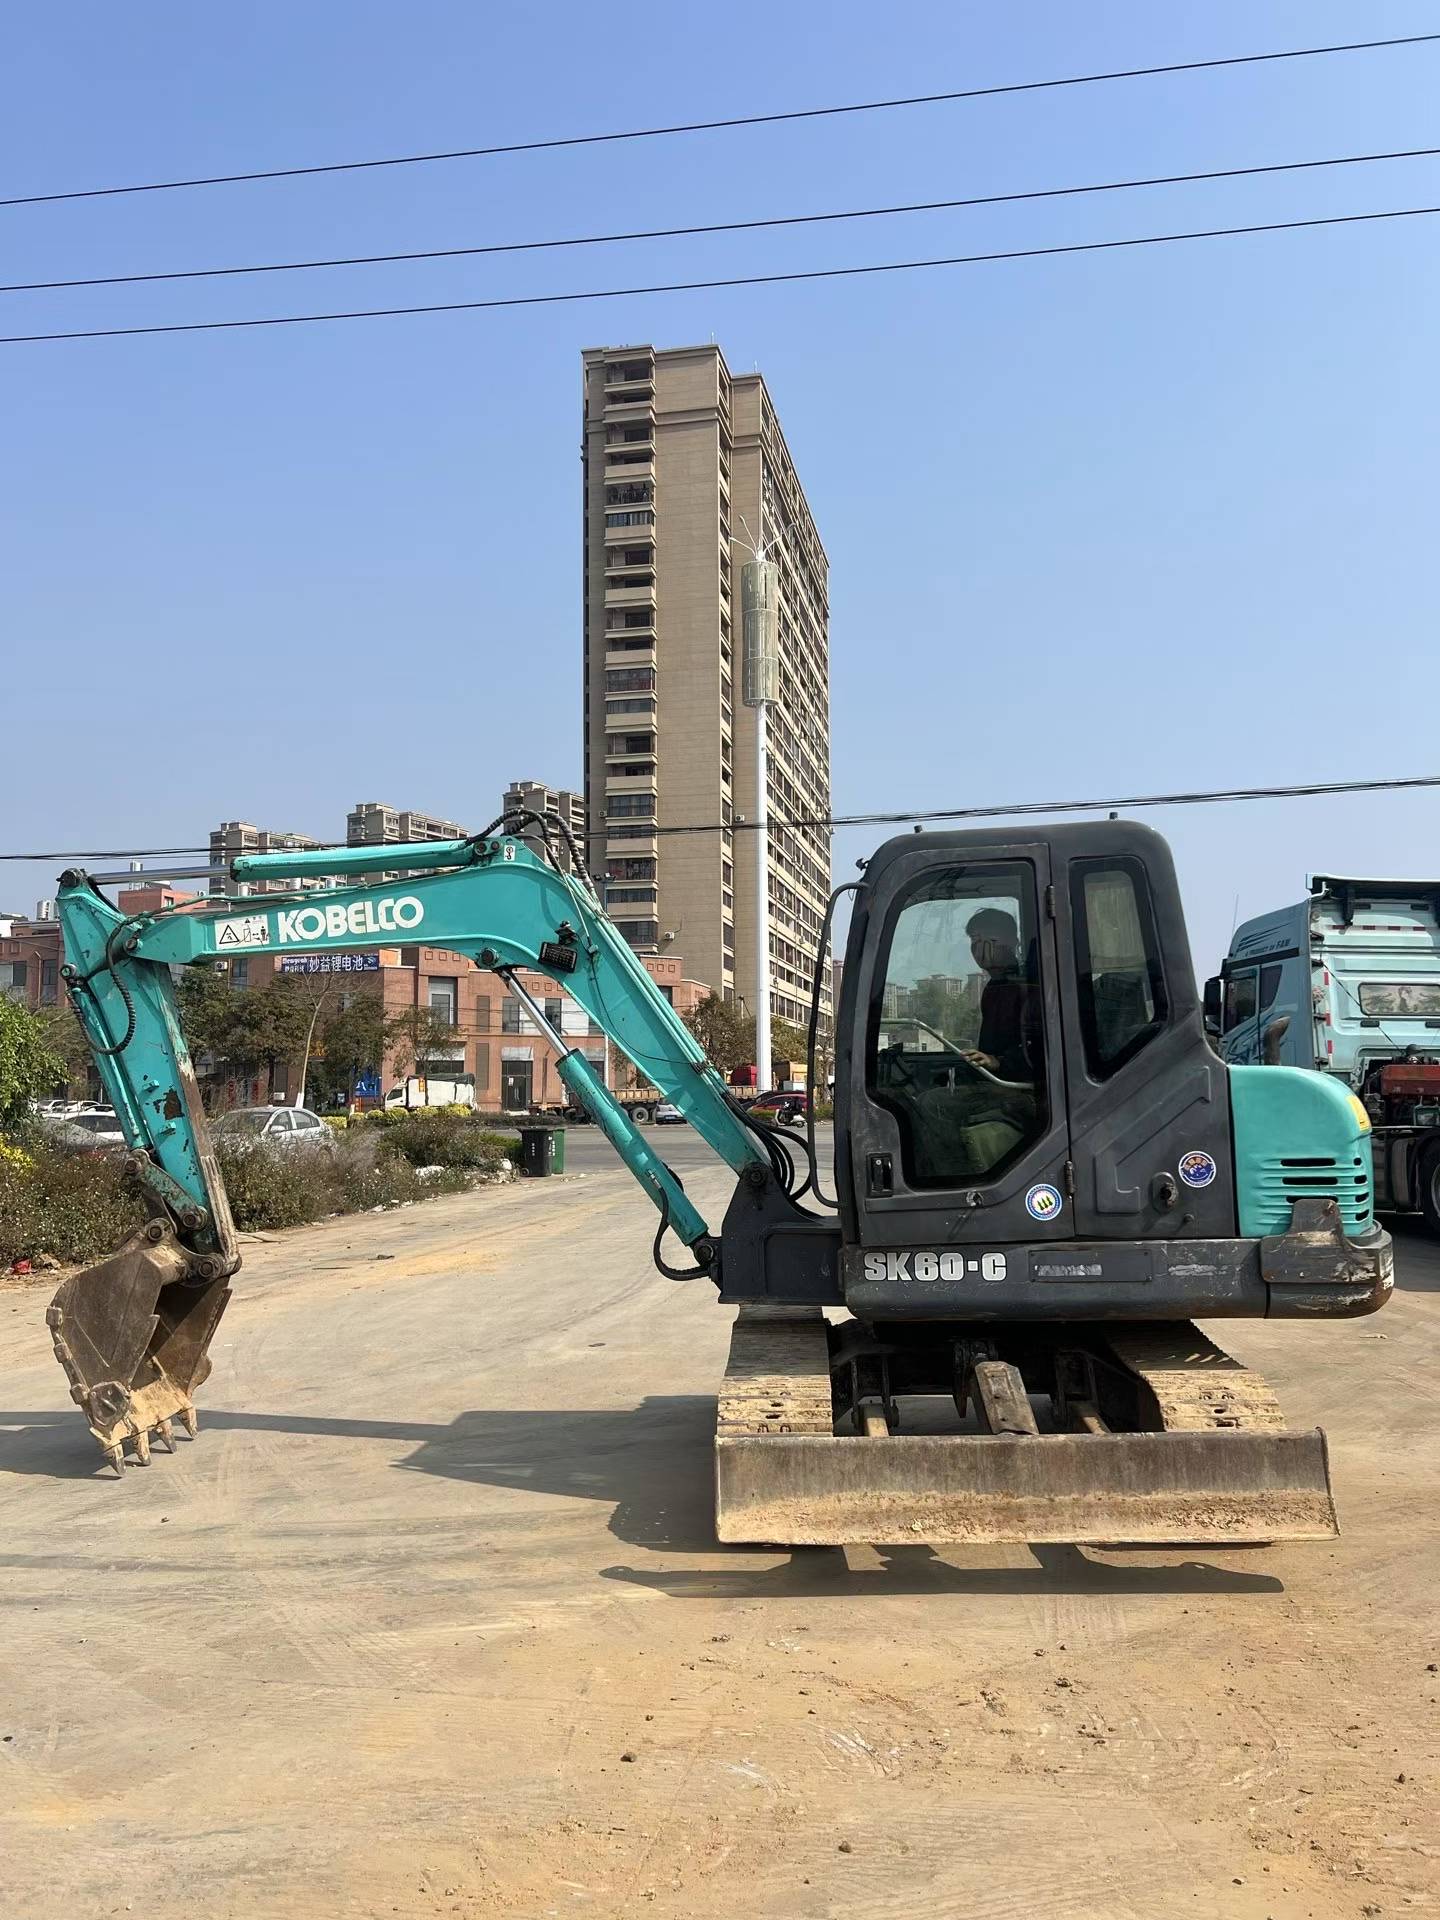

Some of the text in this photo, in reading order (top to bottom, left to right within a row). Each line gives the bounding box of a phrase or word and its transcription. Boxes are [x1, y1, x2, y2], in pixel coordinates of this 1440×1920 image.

[277, 896, 425, 943] KOBELCO
[308, 954, 363, 973] 妙益锂电池
